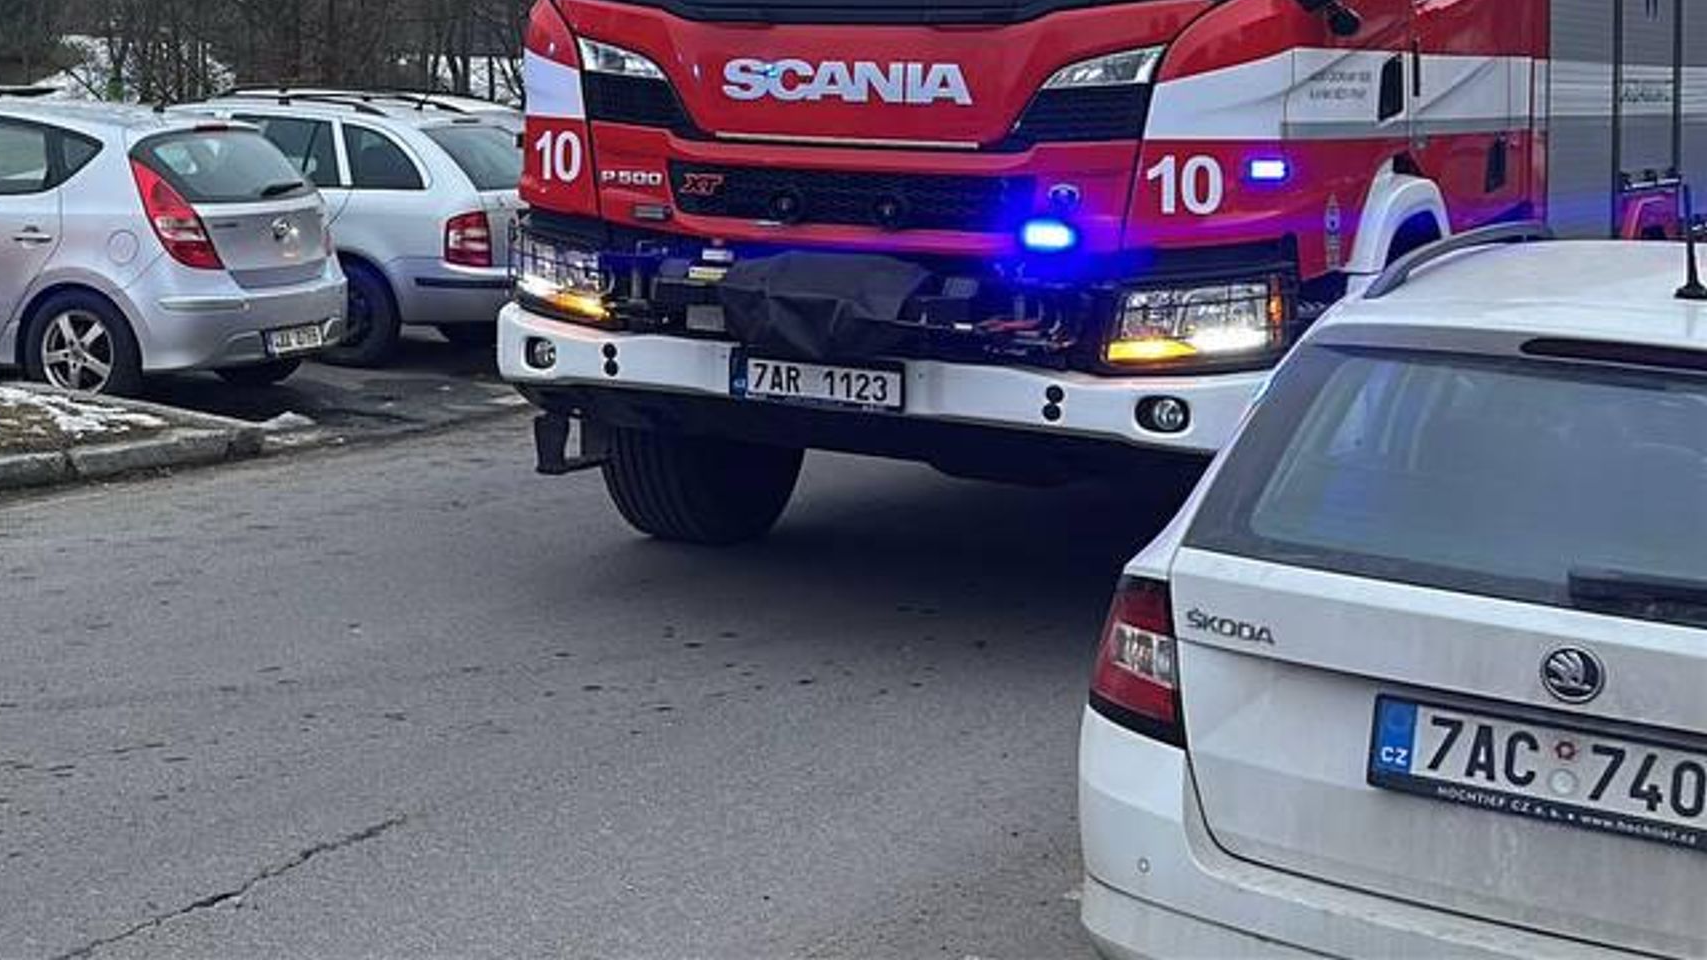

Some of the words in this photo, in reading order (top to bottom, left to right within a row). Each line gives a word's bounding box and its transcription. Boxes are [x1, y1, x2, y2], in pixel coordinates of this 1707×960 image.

[722, 58, 973, 106] SCANIA
[536, 130, 582, 182] 10
[601, 170, 616, 182] P
[618, 171, 663, 186] 500
[1147, 154, 1224, 216] 10
[752, 362, 800, 393] 7AR
[821, 370, 889, 403] 1123
[1185, 607, 1276, 645] ŠKODA
[1380, 745, 1407, 765] CZ
[1427, 715, 1539, 787] 7AC
[1587, 743, 1707, 818] 740
[1510, 799, 1531, 813] CZ
